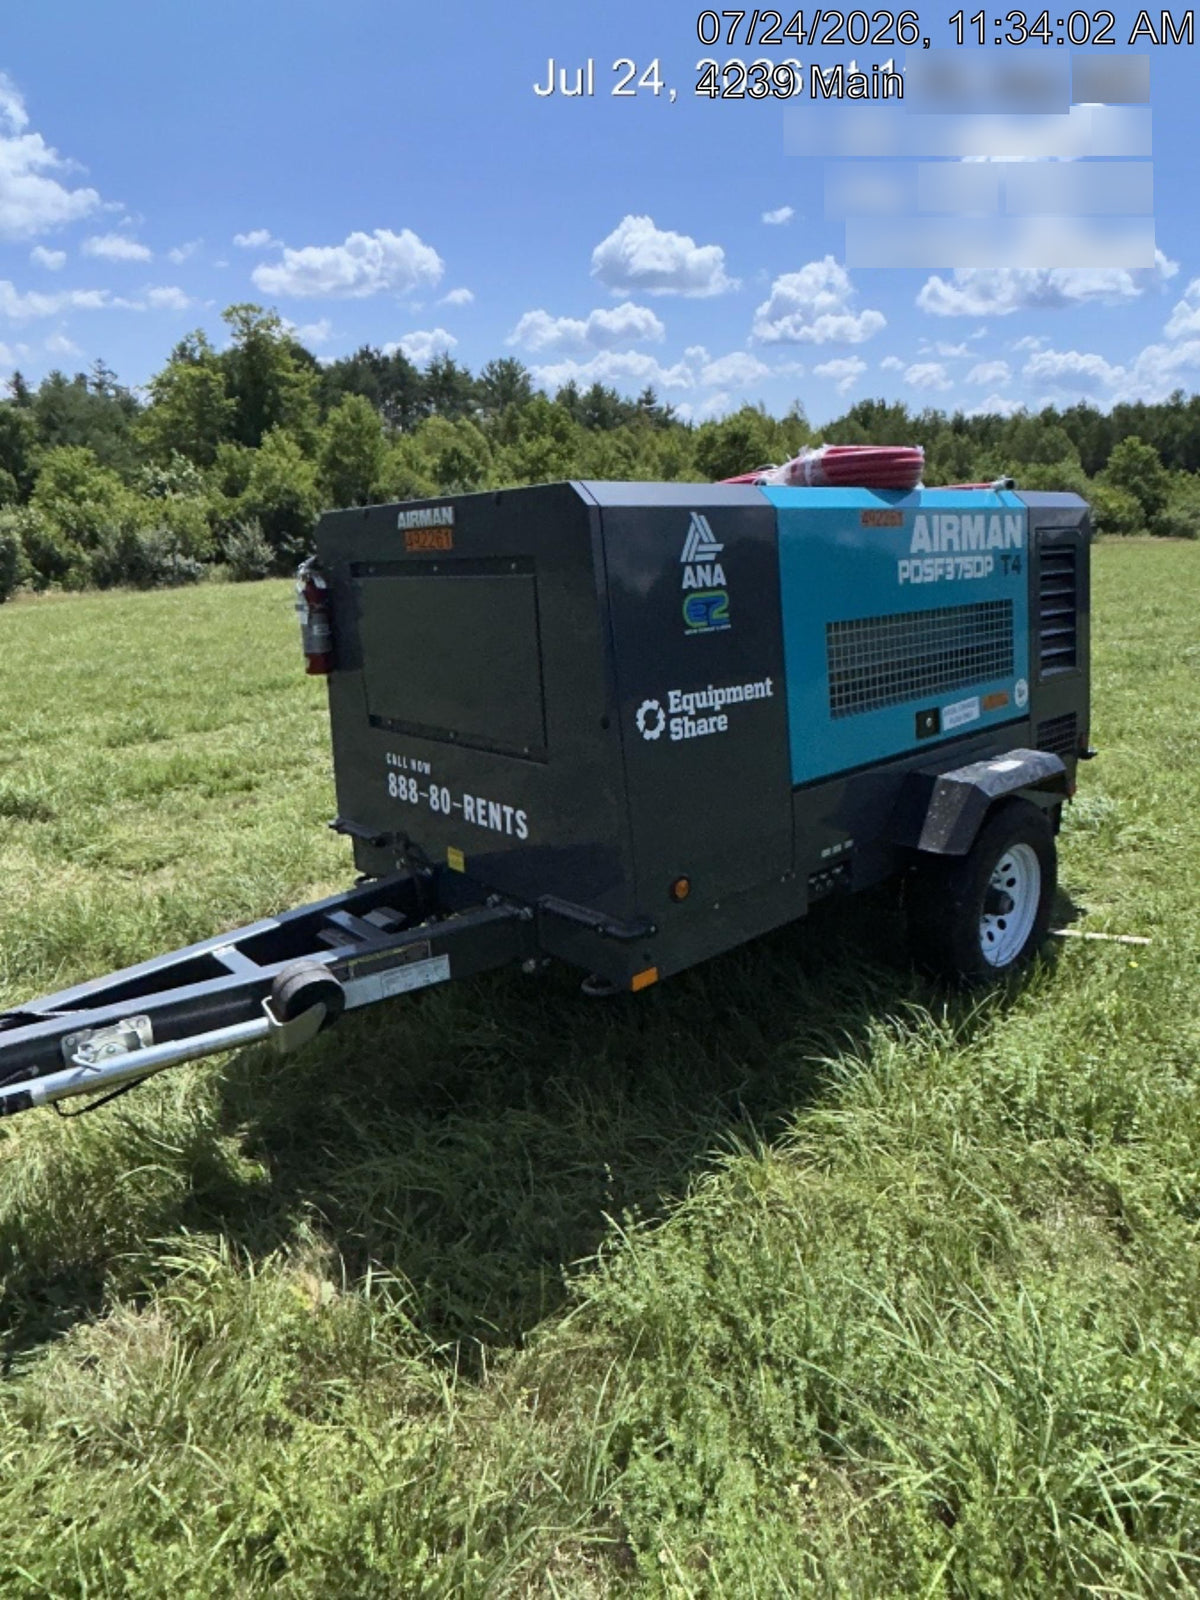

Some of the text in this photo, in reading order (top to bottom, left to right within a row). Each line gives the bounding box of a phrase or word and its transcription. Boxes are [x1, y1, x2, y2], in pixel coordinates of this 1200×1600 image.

[397, 506, 453, 529] AIRMAN
[910, 514, 1023, 553] AIRMAN
[682, 563, 727, 589] ANA
[1001, 554, 1022, 576] T4
[668, 677, 773, 715] Equipment
[670, 714, 728, 741] Share
[386, 752, 431, 775] CALL NOW
[388, 772, 529, 839] 888-80-RENTS
